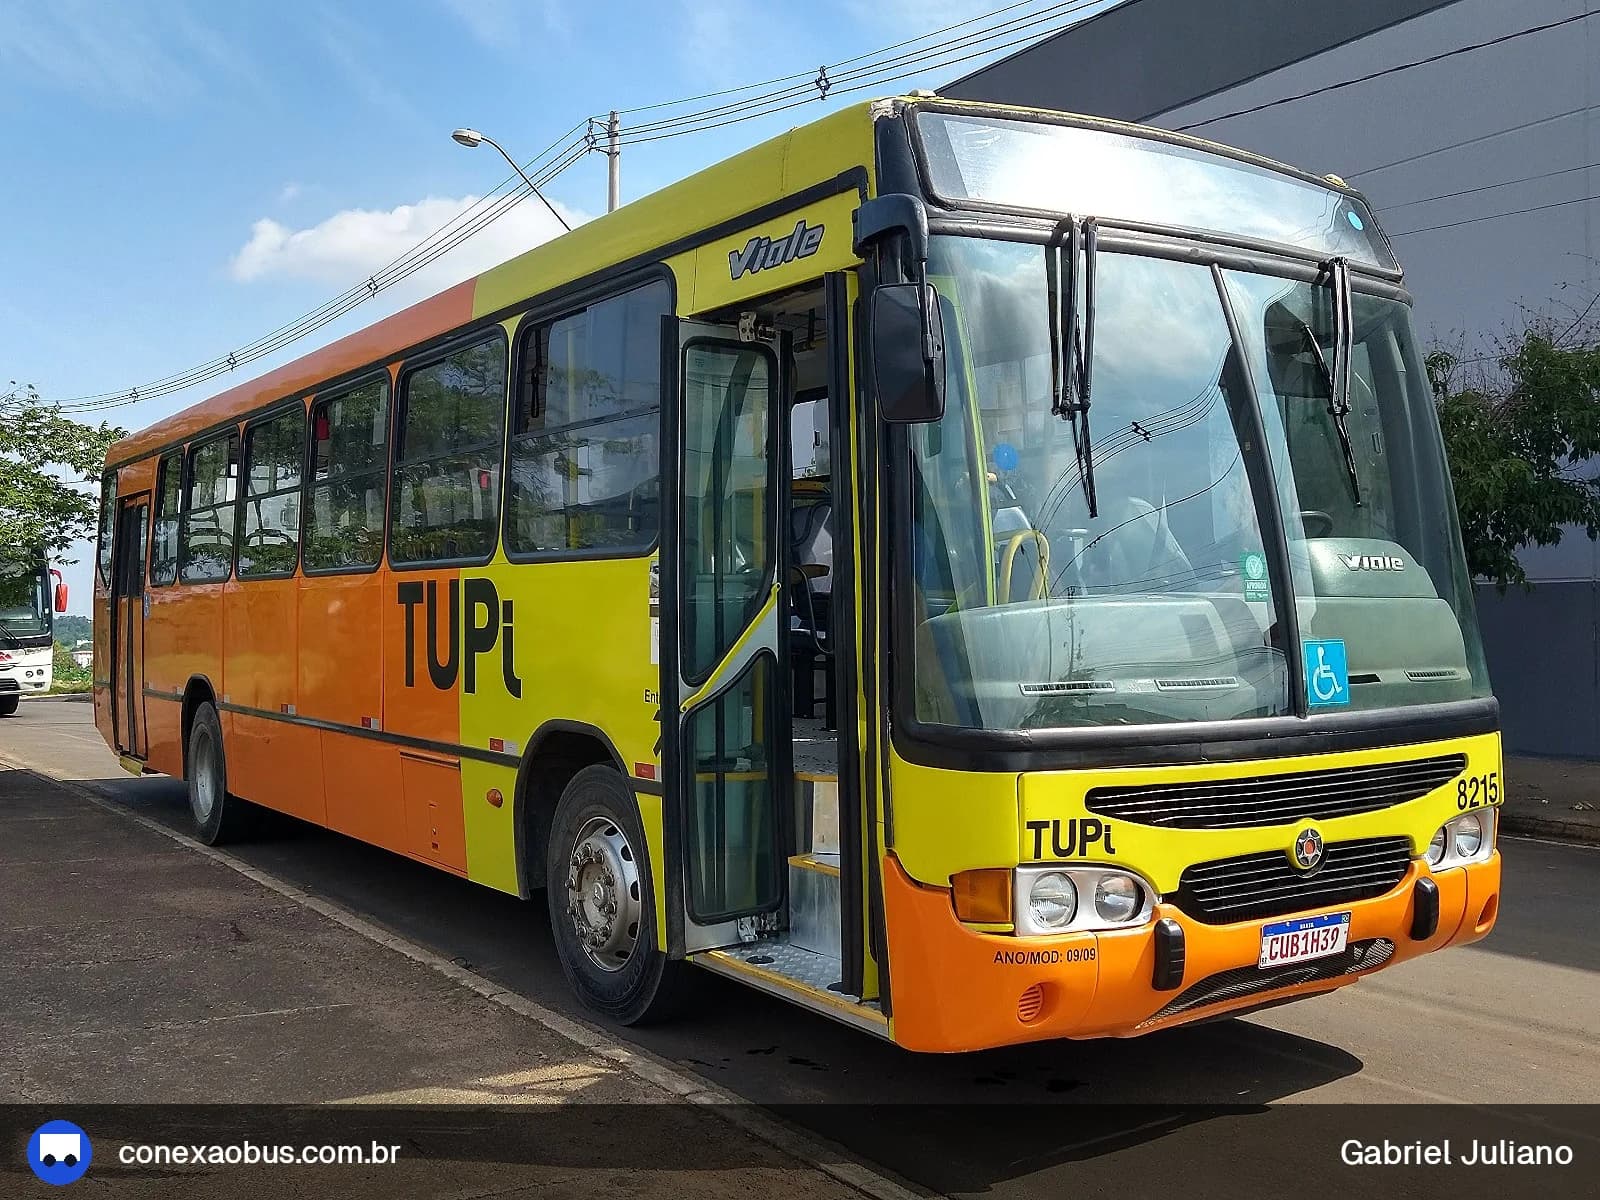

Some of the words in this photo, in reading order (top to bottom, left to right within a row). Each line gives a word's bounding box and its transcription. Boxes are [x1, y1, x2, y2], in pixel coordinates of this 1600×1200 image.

[728, 219, 825, 280] Viale
[1457, 772, 1498, 810] 8215
[993, 950, 1063, 965] ANO/MOD:
[1066, 948, 1096, 962] 09/09
[1269, 926, 1340, 961] CUB1H39
